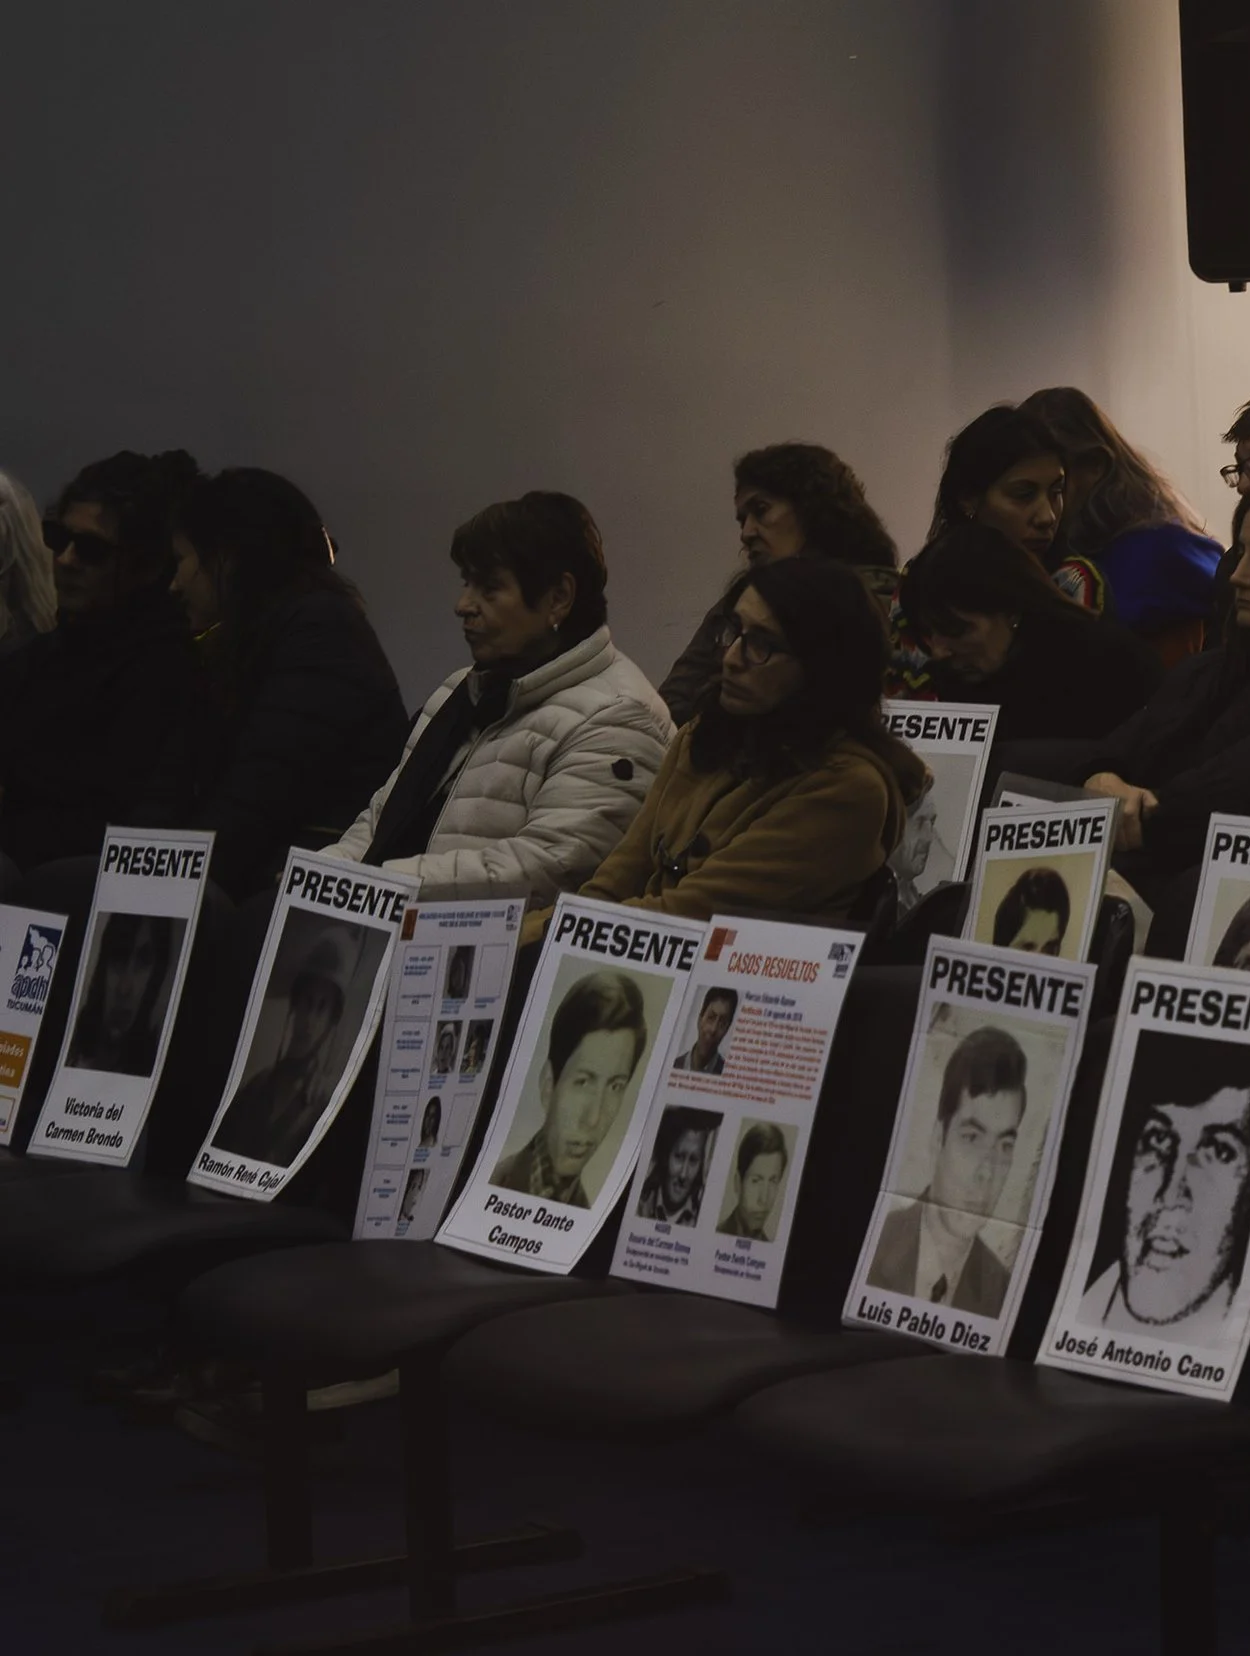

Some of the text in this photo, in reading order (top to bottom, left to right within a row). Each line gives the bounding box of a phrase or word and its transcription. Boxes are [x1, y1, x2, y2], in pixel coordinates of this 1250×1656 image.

[985, 816, 1106, 851] PRESENTE
[103, 844, 205, 879] PRESENTE
[285, 865, 409, 922] PRESENTE
[555, 913, 699, 971] PRESENTE
[727, 951, 763, 975] CASOS
[761, 956, 820, 983] RESUELTOS
[930, 955, 1083, 1018] PRESENTE
[64, 1097, 125, 1121] Victoria del
[45, 1120, 124, 1148] Carmen Brondo
[198, 1152, 285, 1192] Ramón René Cajal
[484, 1194, 574, 1232] Pastor Dante
[488, 1225, 543, 1254] Campos
[857, 1296, 991, 1351] Luis Pablo Diez
[1055, 1330, 1225, 1381] José Antonio Cano
